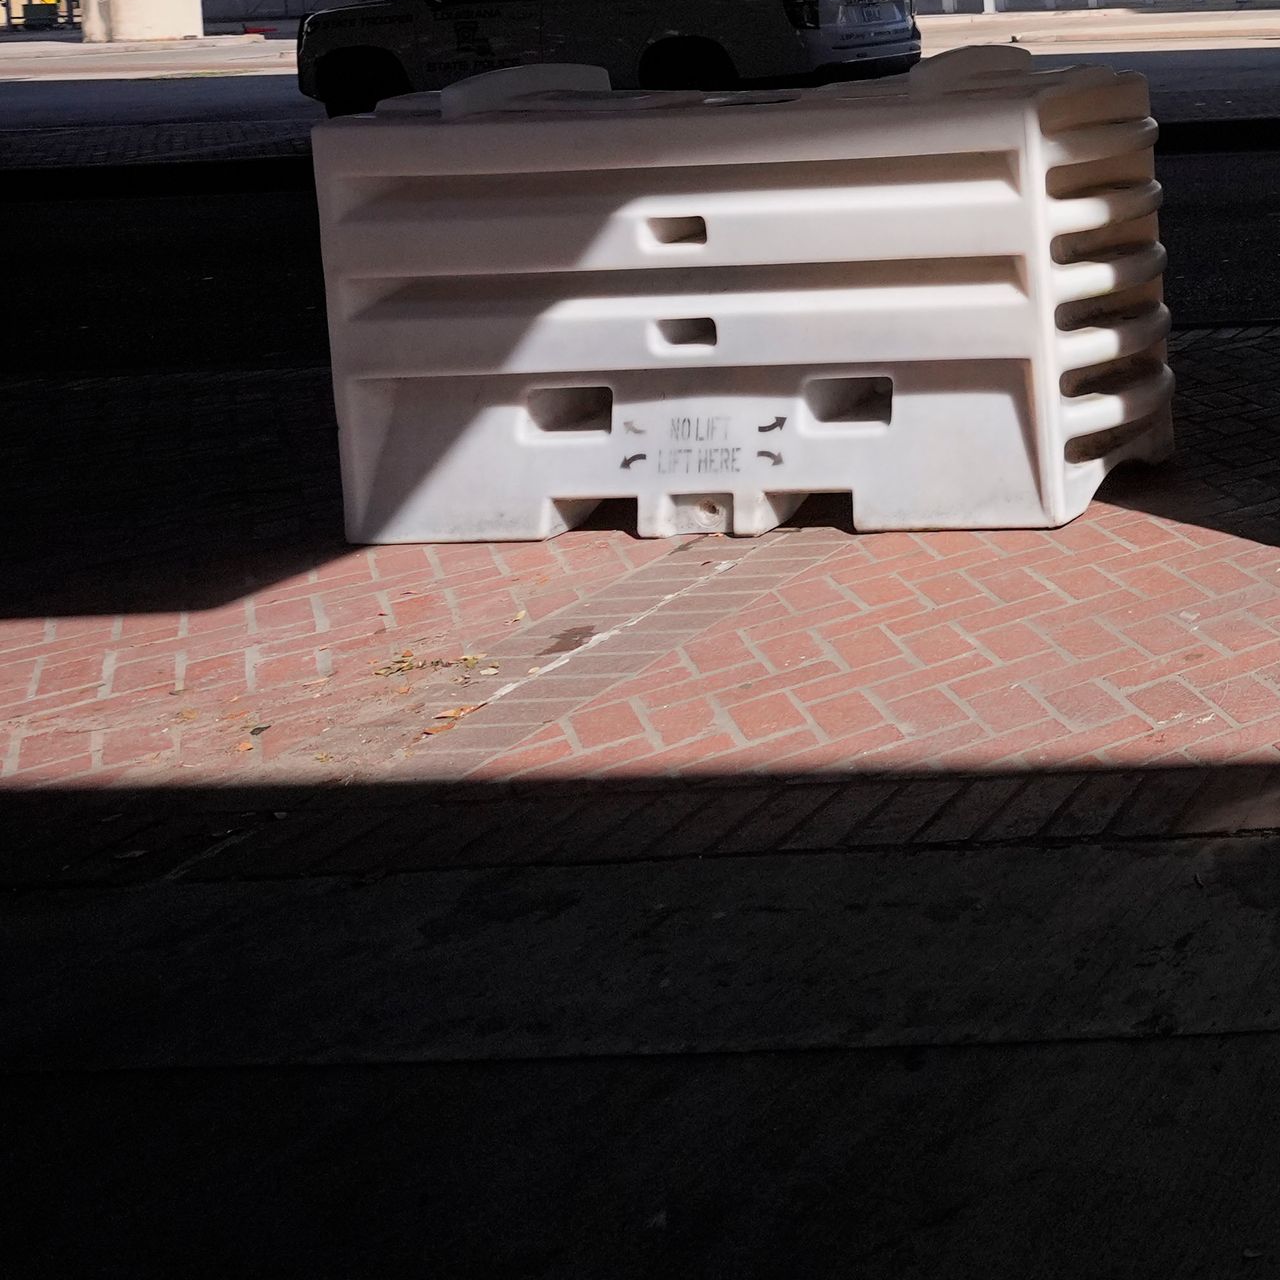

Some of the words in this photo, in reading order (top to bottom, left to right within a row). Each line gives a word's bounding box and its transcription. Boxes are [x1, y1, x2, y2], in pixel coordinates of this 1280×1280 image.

[669, 417, 691, 441] NO
[695, 416, 731, 441] LIFT
[657, 448, 693, 474] LIFT
[698, 447, 741, 473] HERE
